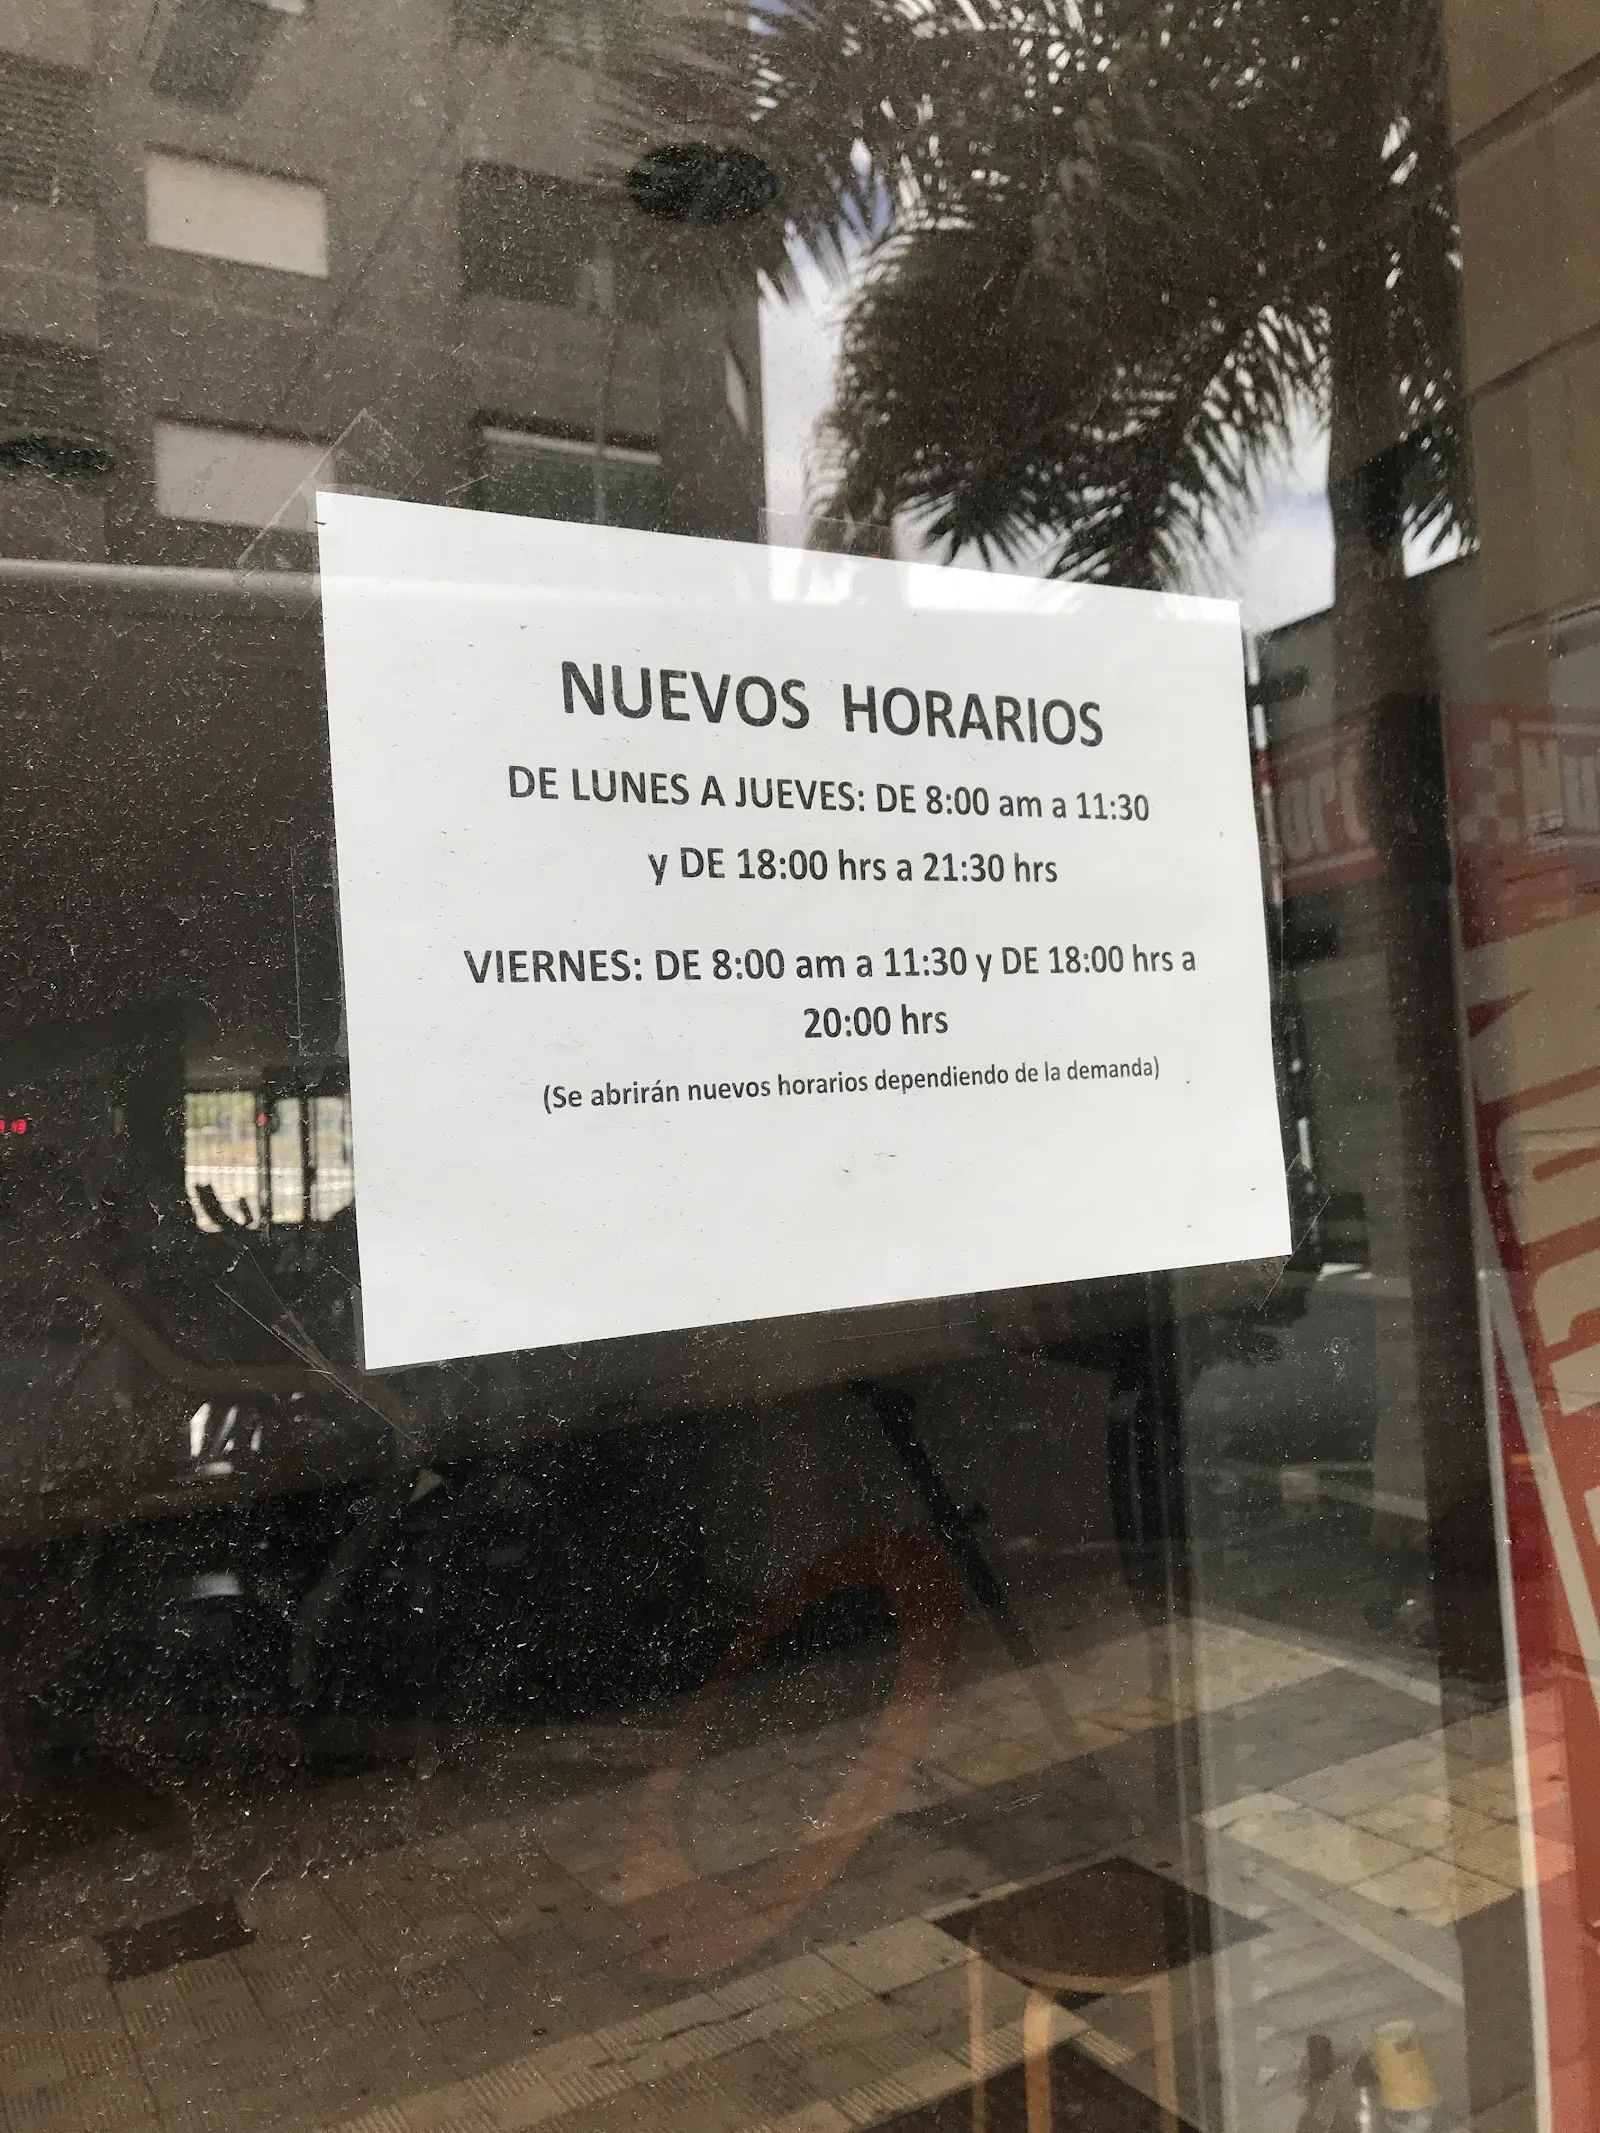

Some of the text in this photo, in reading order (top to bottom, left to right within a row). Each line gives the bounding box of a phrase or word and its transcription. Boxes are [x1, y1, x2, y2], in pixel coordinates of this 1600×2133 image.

[561, 660, 1104, 748] NUEVOS HORARIOS
[508, 765, 1150, 822] DE LUNES A JUEVES: DE 8:00 am a 11:30
[647, 846, 1058, 886] y DE 18:00 hrs a 21:30 hrs
[463, 943, 1196, 984] VIERNES: DE 8:00 am a 11:30 y DE 18:00 hrs a
[803, 1003, 949, 1039] 20:00 hrs
[543, 1055, 1160, 1115] (Se abrirán nuevos horarios dependiendo de la demanda)
